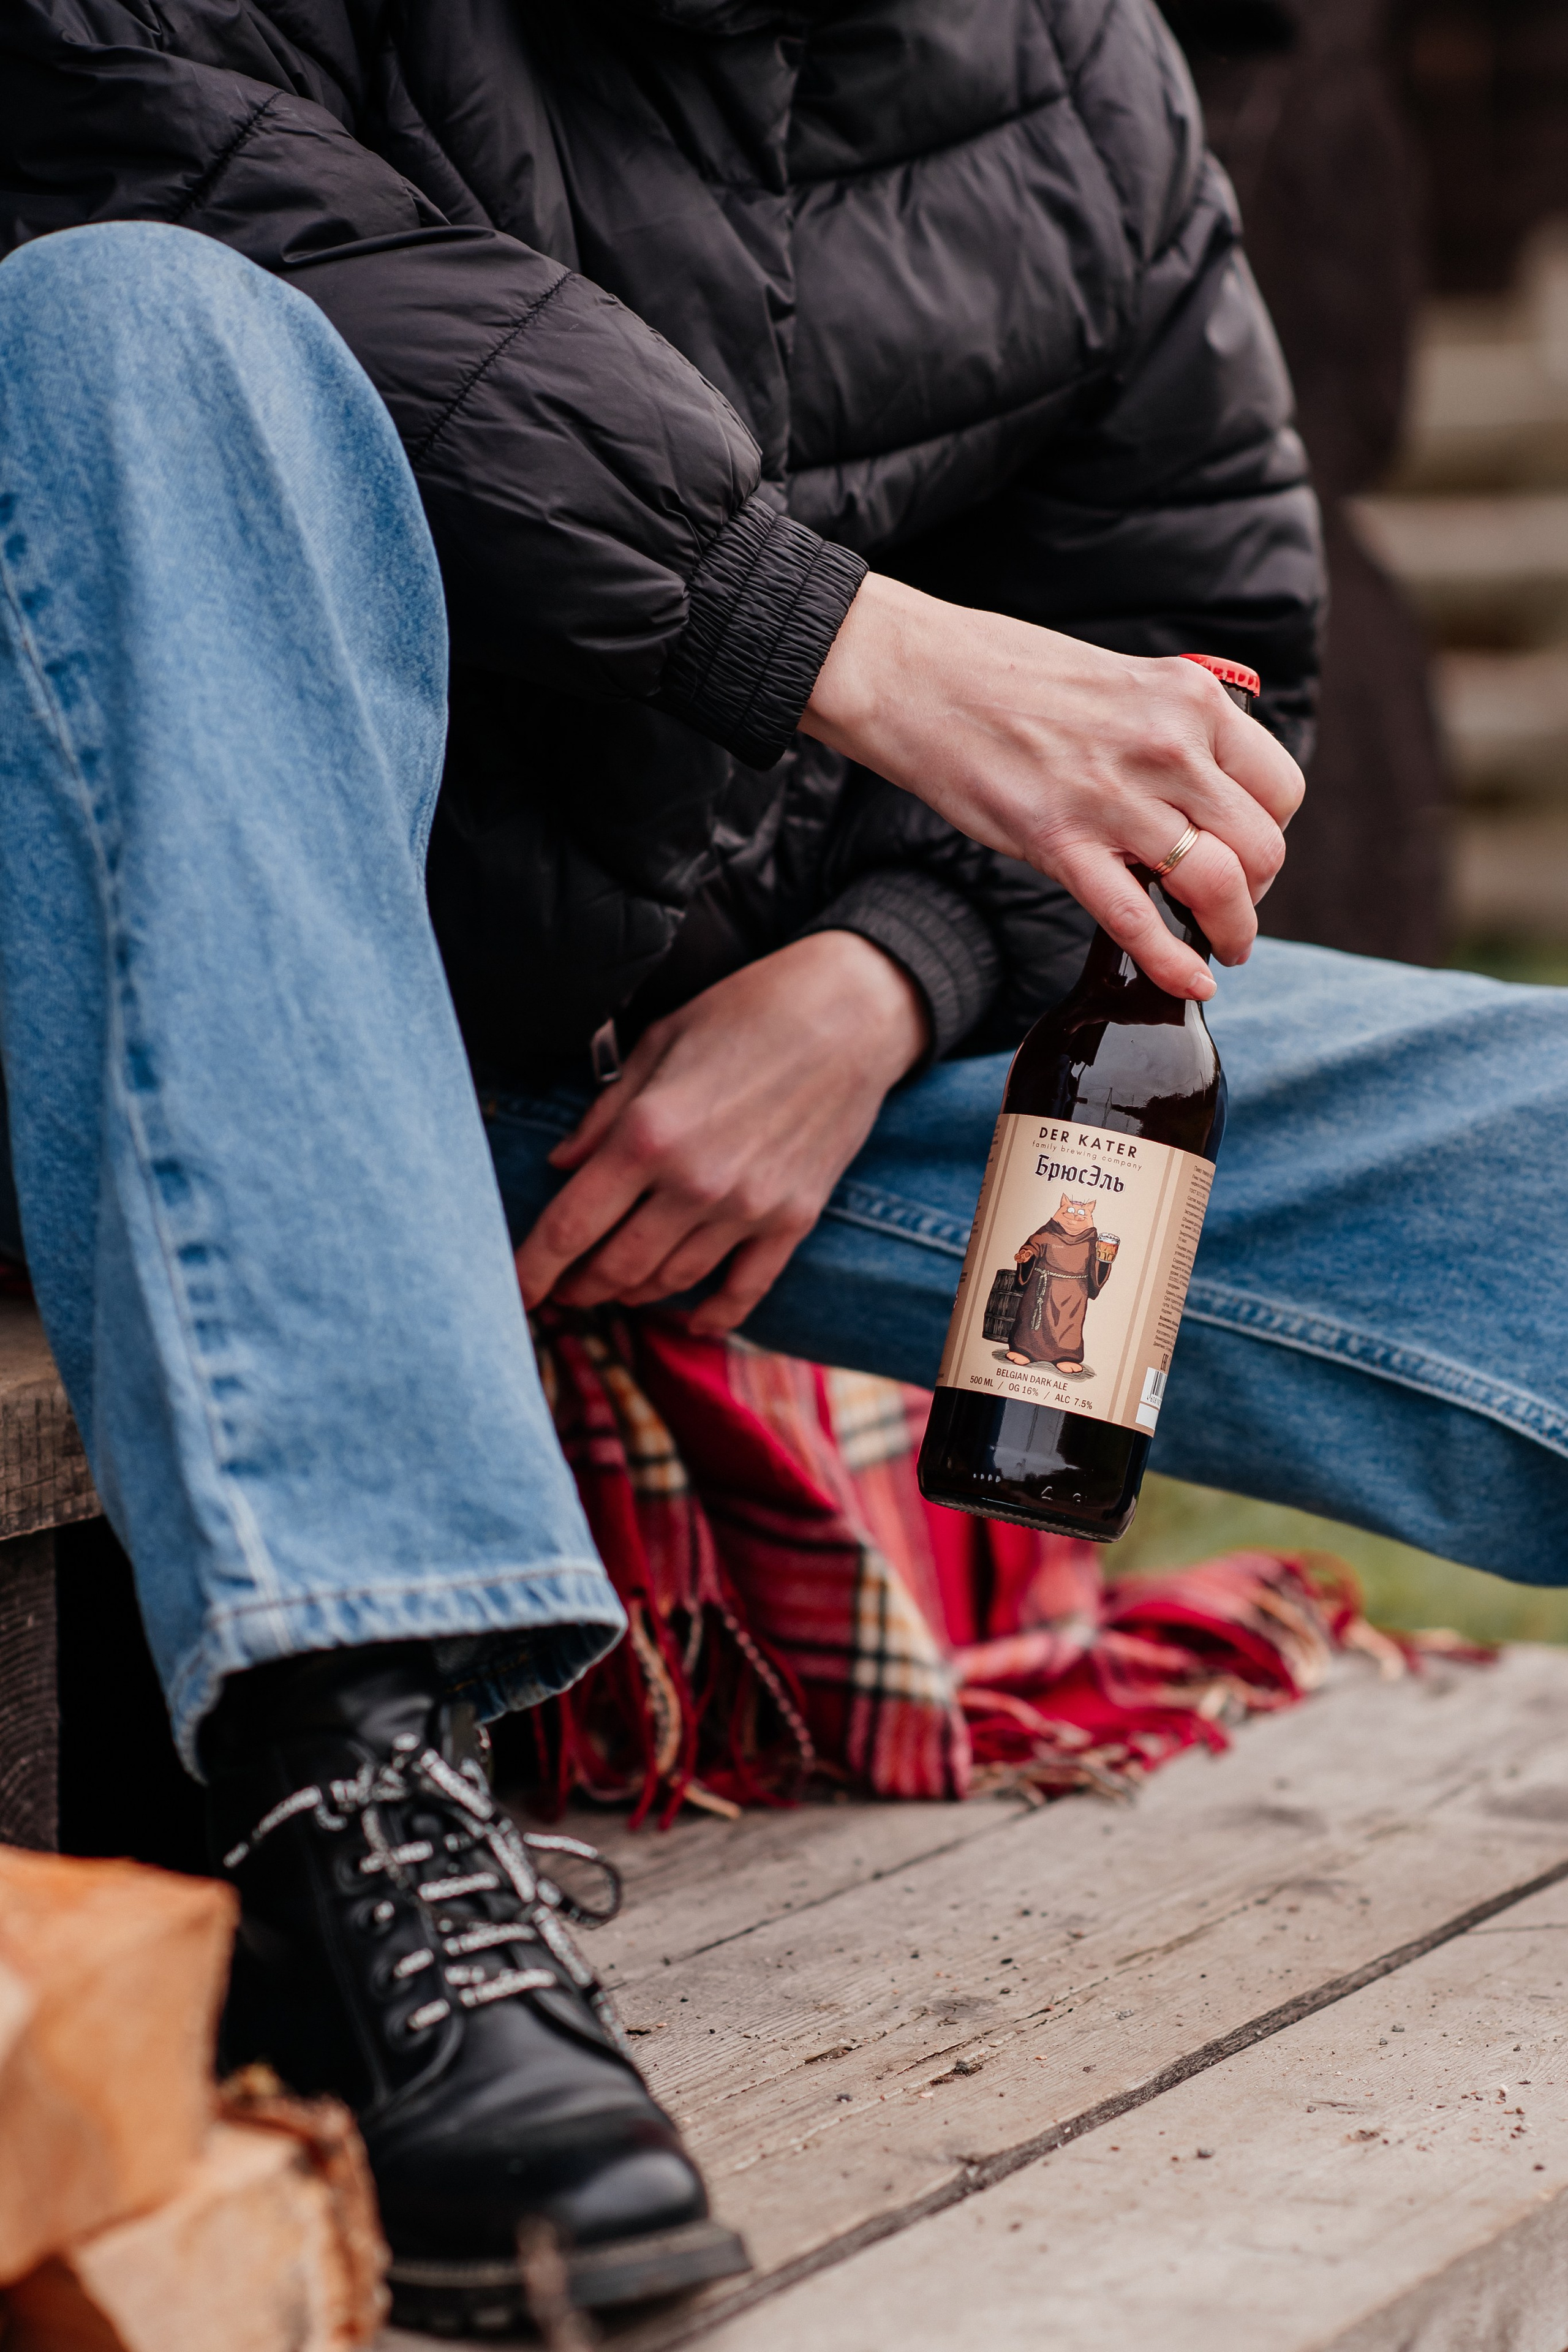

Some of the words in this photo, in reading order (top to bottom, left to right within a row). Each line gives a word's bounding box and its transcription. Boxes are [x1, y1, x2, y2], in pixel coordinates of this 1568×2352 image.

[1032, 1140, 1057, 1152] family
[1061, 1145, 1097, 1161] brewing
[1101, 1156, 1142, 1171] company
[1039, 1126, 1069, 1143] DER
[1078, 1134, 1137, 1158] KATER
[1035, 1154, 1125, 1193] БрюсЭль
[970, 1375, 983, 1385] 500
[983, 1378, 993, 1387] ML
[1008, 1382, 1020, 1392] OG
[1022, 1385, 1039, 1396] 16%
[1054, 1393, 1071, 1404] ALC
[1074, 1397, 1093, 1410] 7.5%
[996, 1368, 1028, 1382] BELGIAN
[1030, 1375, 1052, 1387] DARK
[1052, 1381, 1068, 1391] ALE
